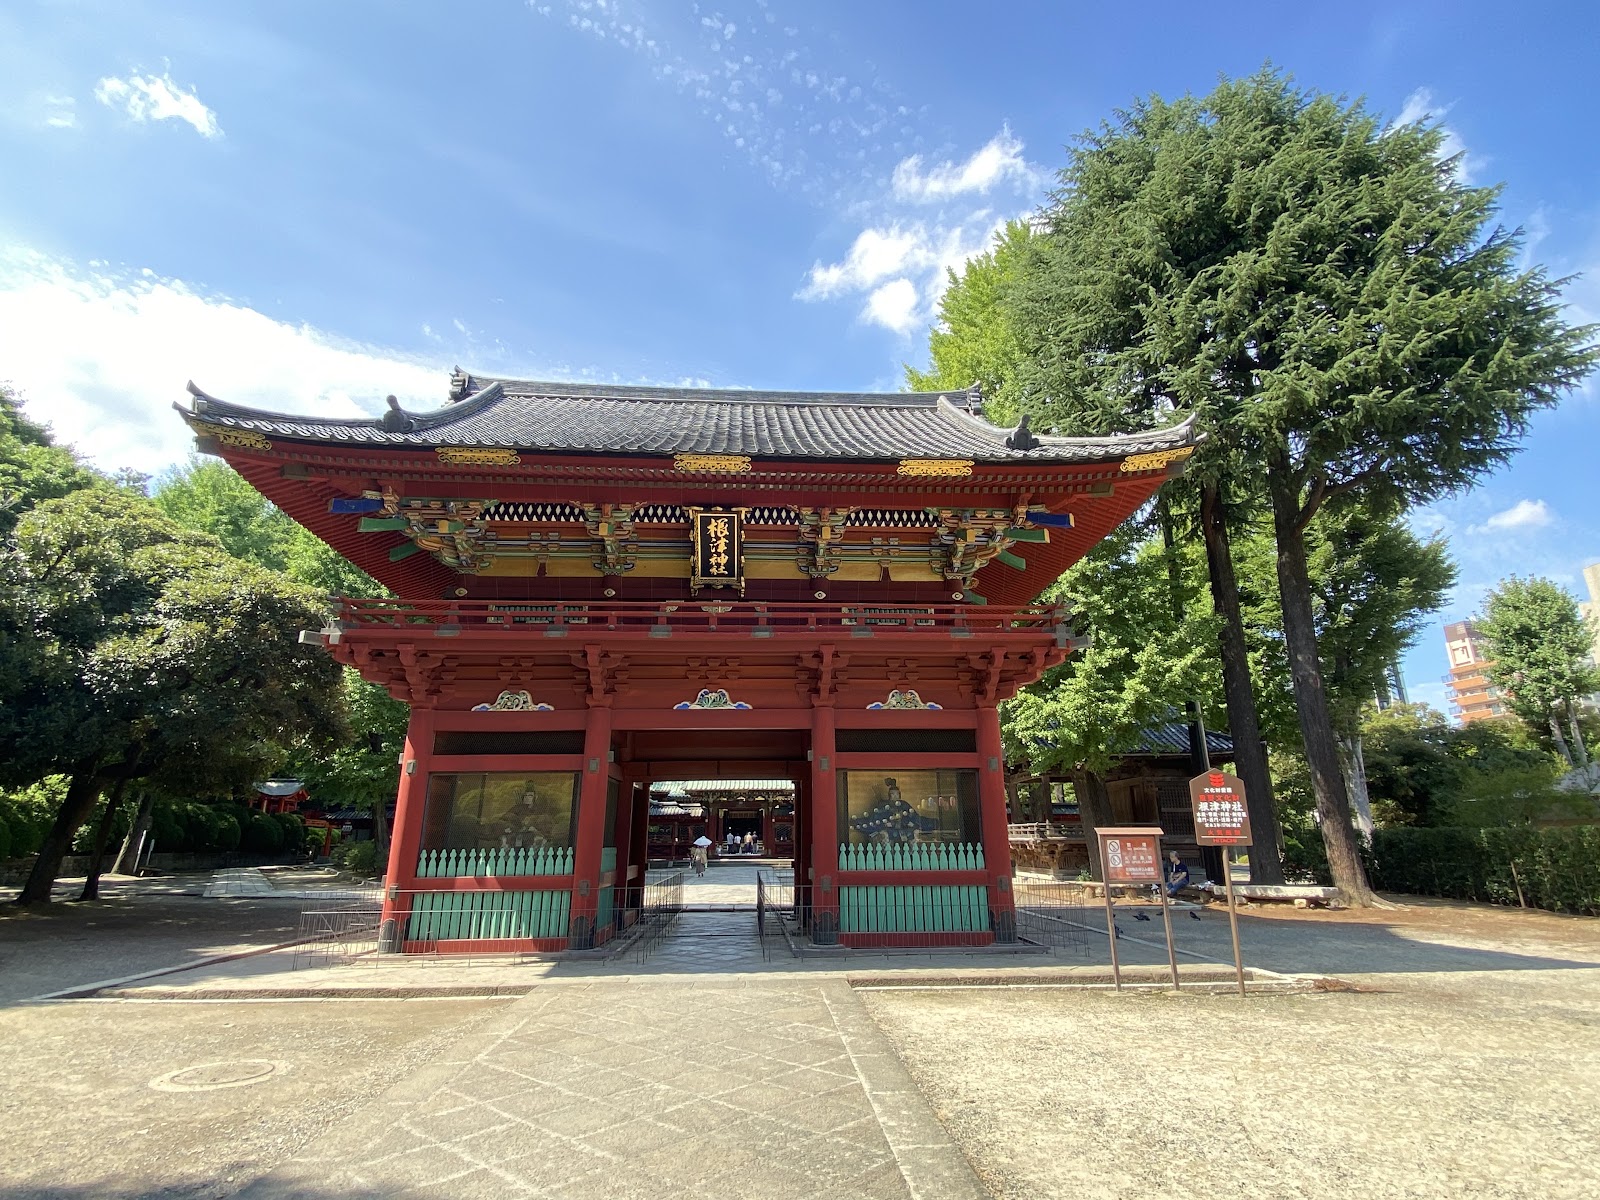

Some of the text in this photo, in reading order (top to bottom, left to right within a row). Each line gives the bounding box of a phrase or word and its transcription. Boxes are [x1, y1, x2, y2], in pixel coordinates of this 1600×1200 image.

[706, 517, 730, 576] 根津神社
[1199, 794, 1240, 802] 重要文化財
[1198, 801, 1244, 812] 根津神社
